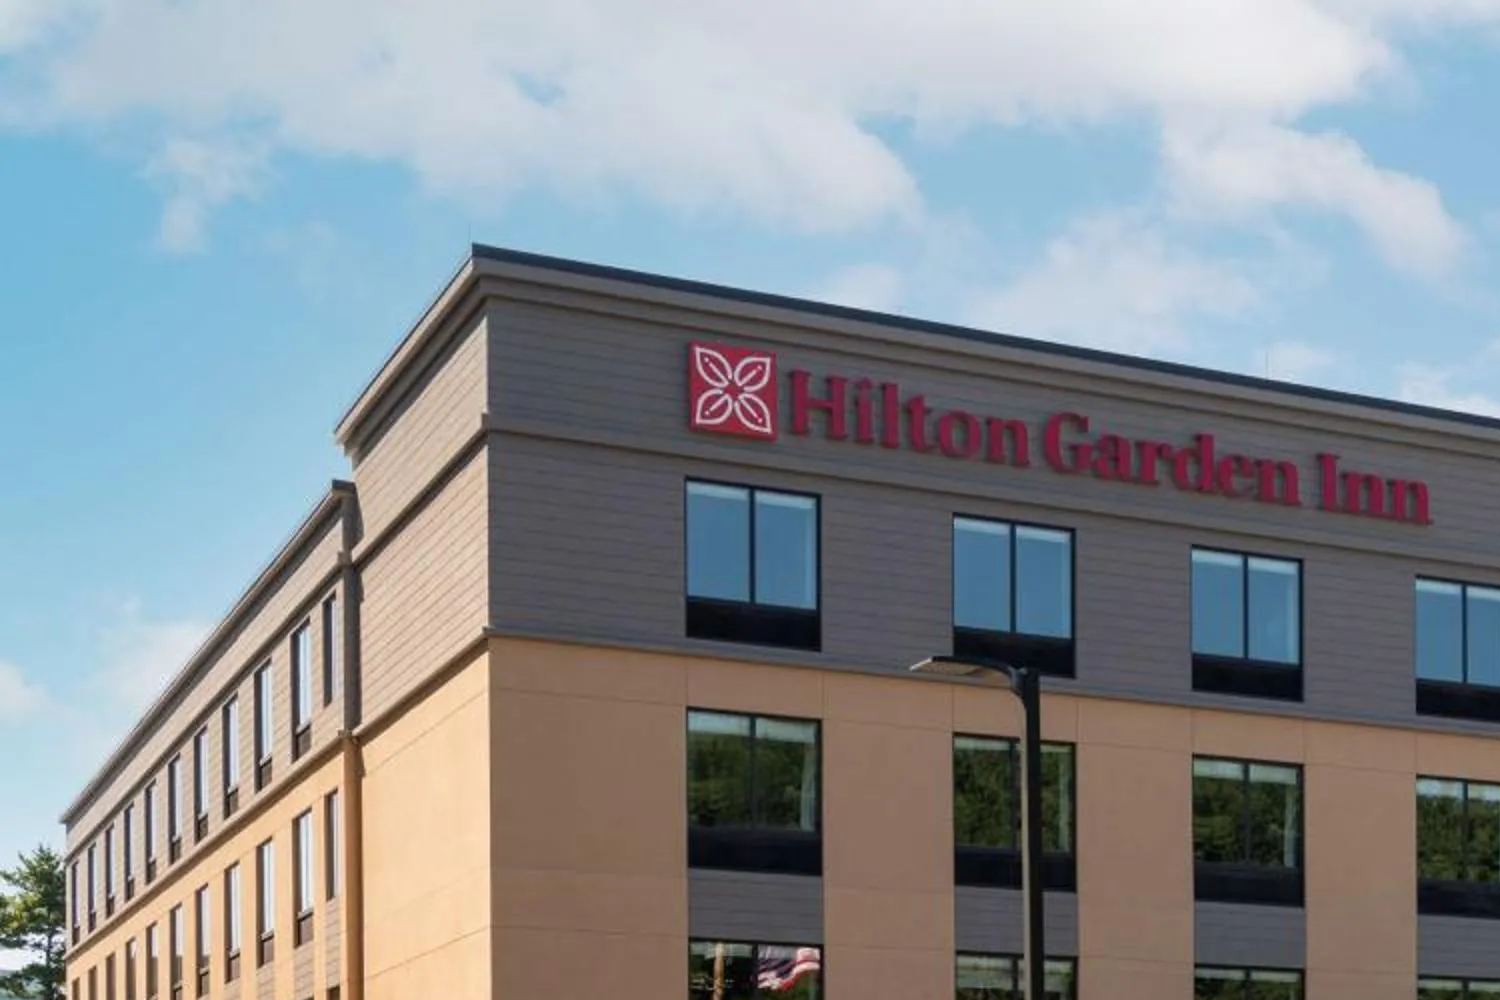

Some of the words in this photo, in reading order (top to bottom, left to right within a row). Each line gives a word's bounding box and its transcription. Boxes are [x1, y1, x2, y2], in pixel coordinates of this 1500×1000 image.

[789, 368, 1031, 468] Hilton
[1043, 411, 1303, 506] Garden
[1316, 452, 1434, 526] Inn
